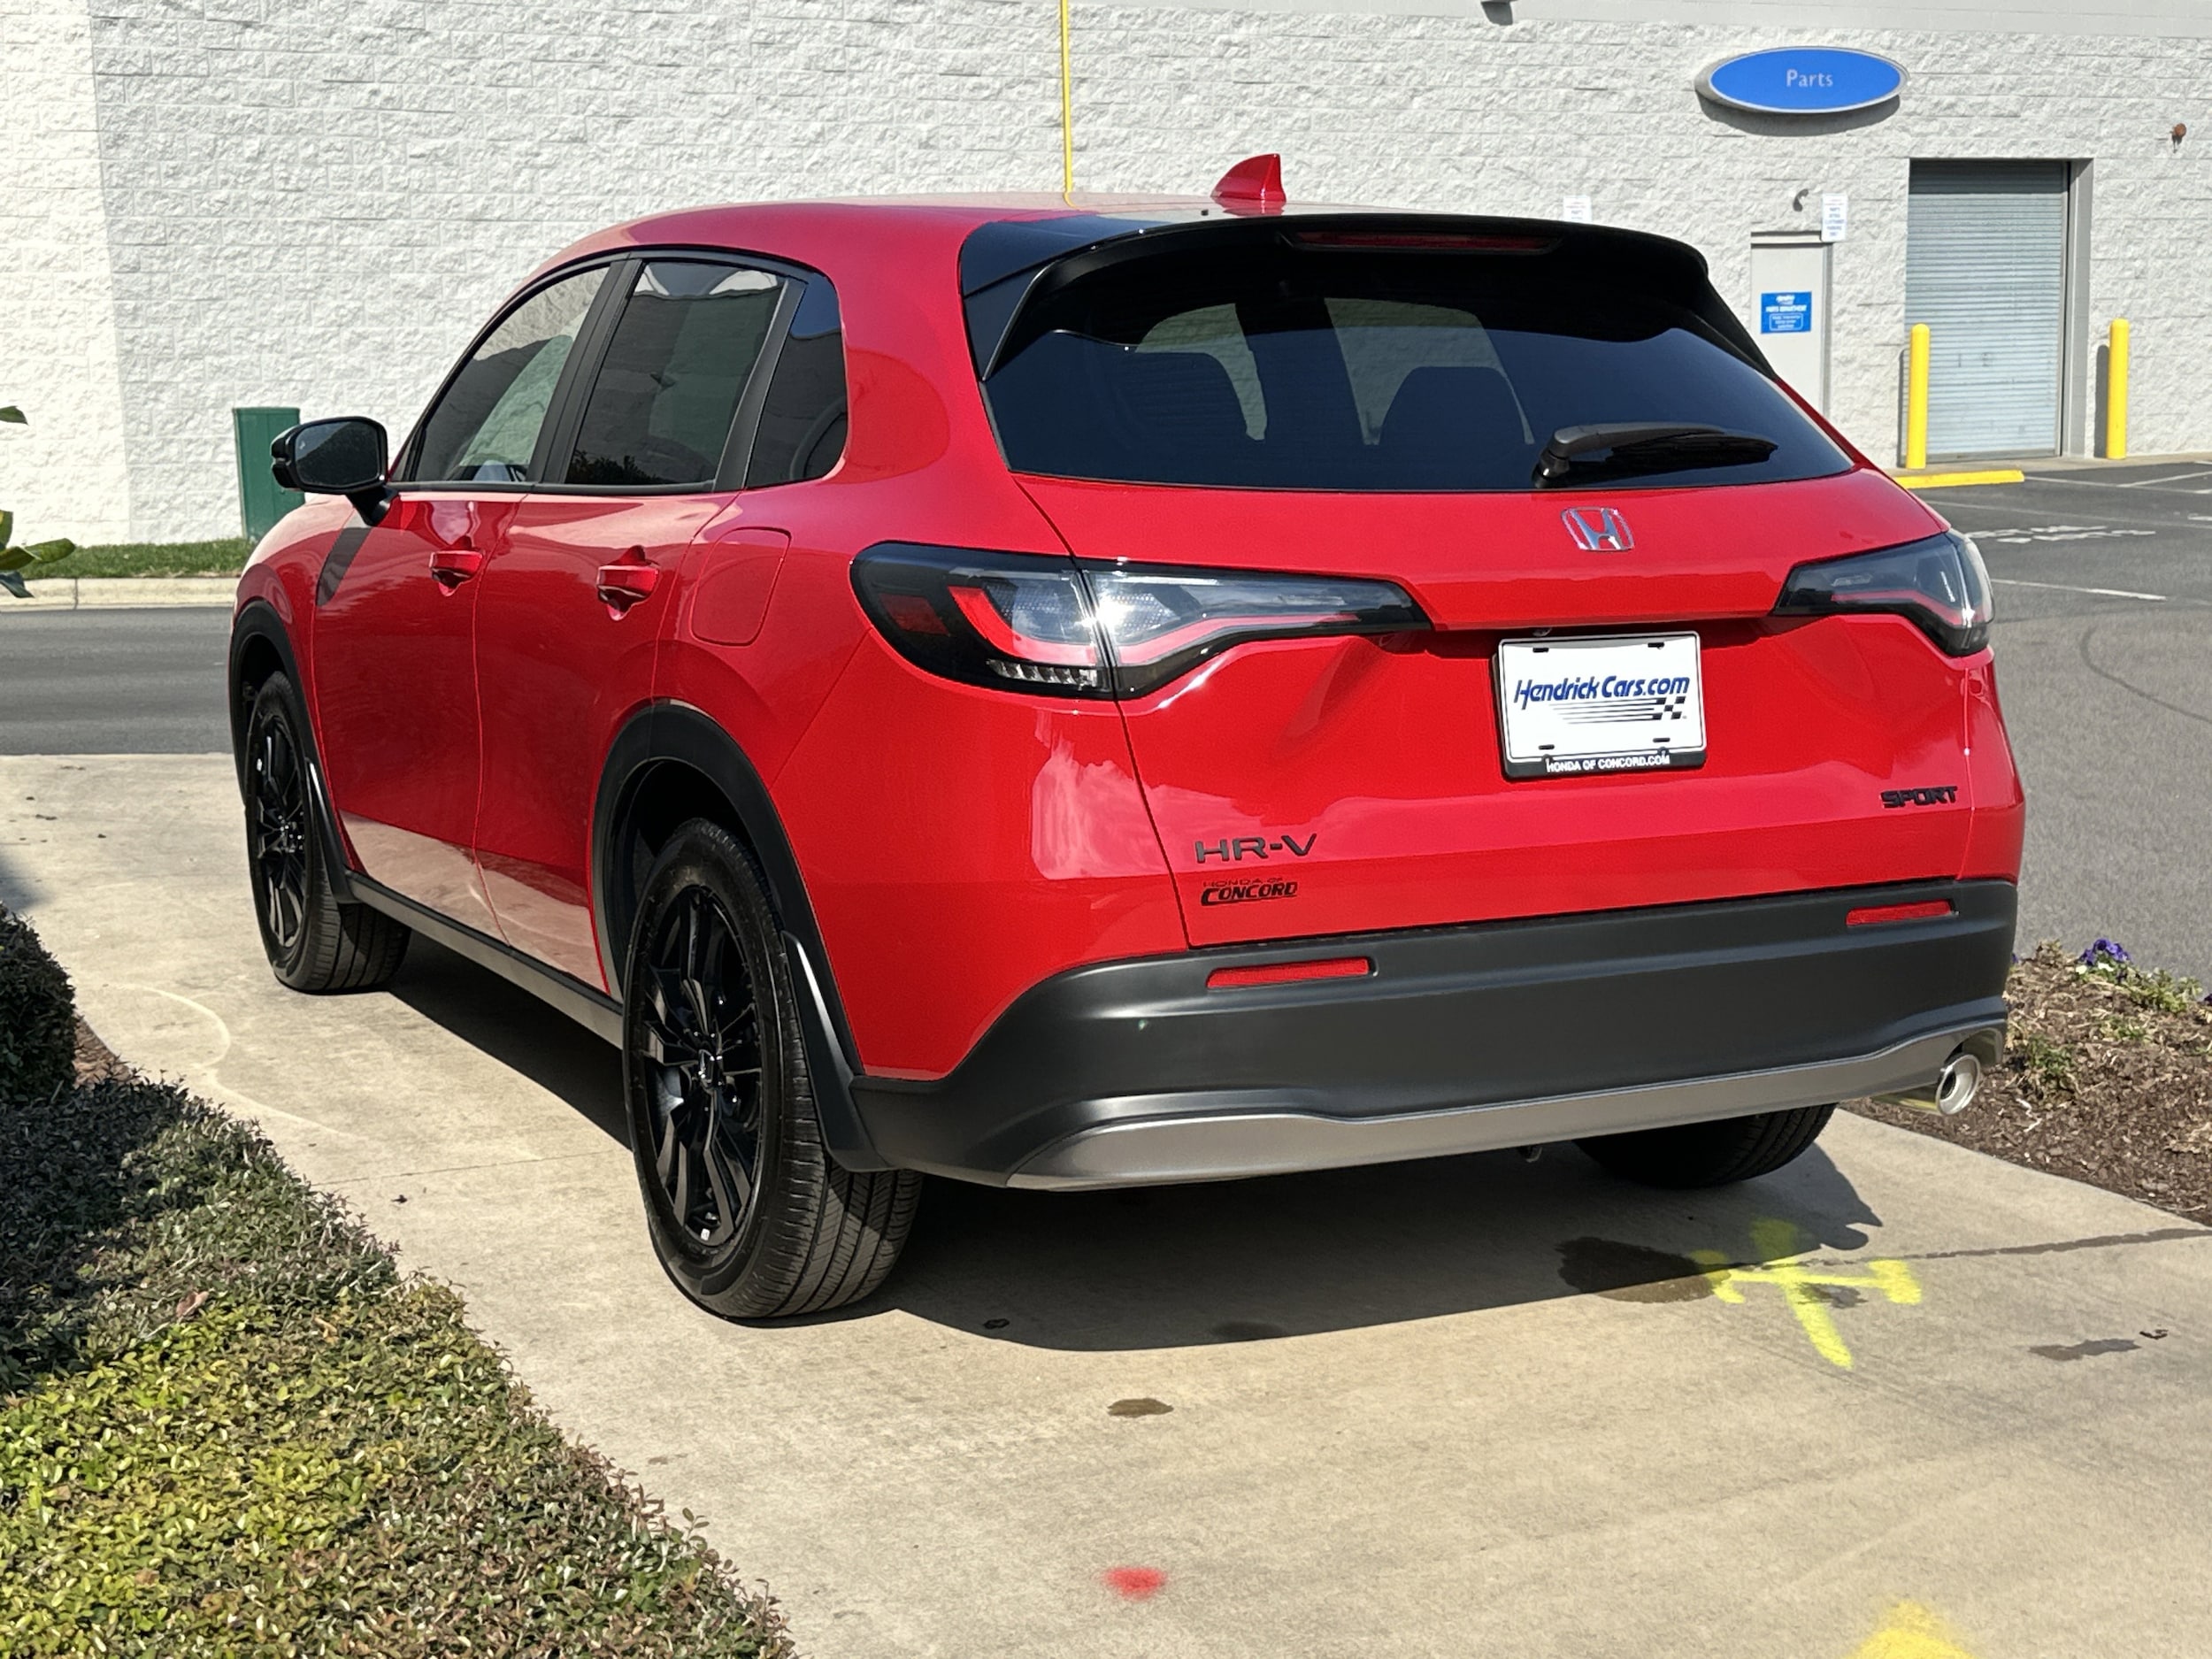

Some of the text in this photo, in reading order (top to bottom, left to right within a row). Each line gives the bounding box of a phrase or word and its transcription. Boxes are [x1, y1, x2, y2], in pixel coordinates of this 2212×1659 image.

[1786, 68, 1834, 88] Parts
[1546, 754, 1671, 772] HONDA OF CONCORD.COM
[1880, 785, 1958, 809] SPORT
[1194, 833, 1317, 864] HR-V
[1201, 881, 1298, 907] CONCORD
